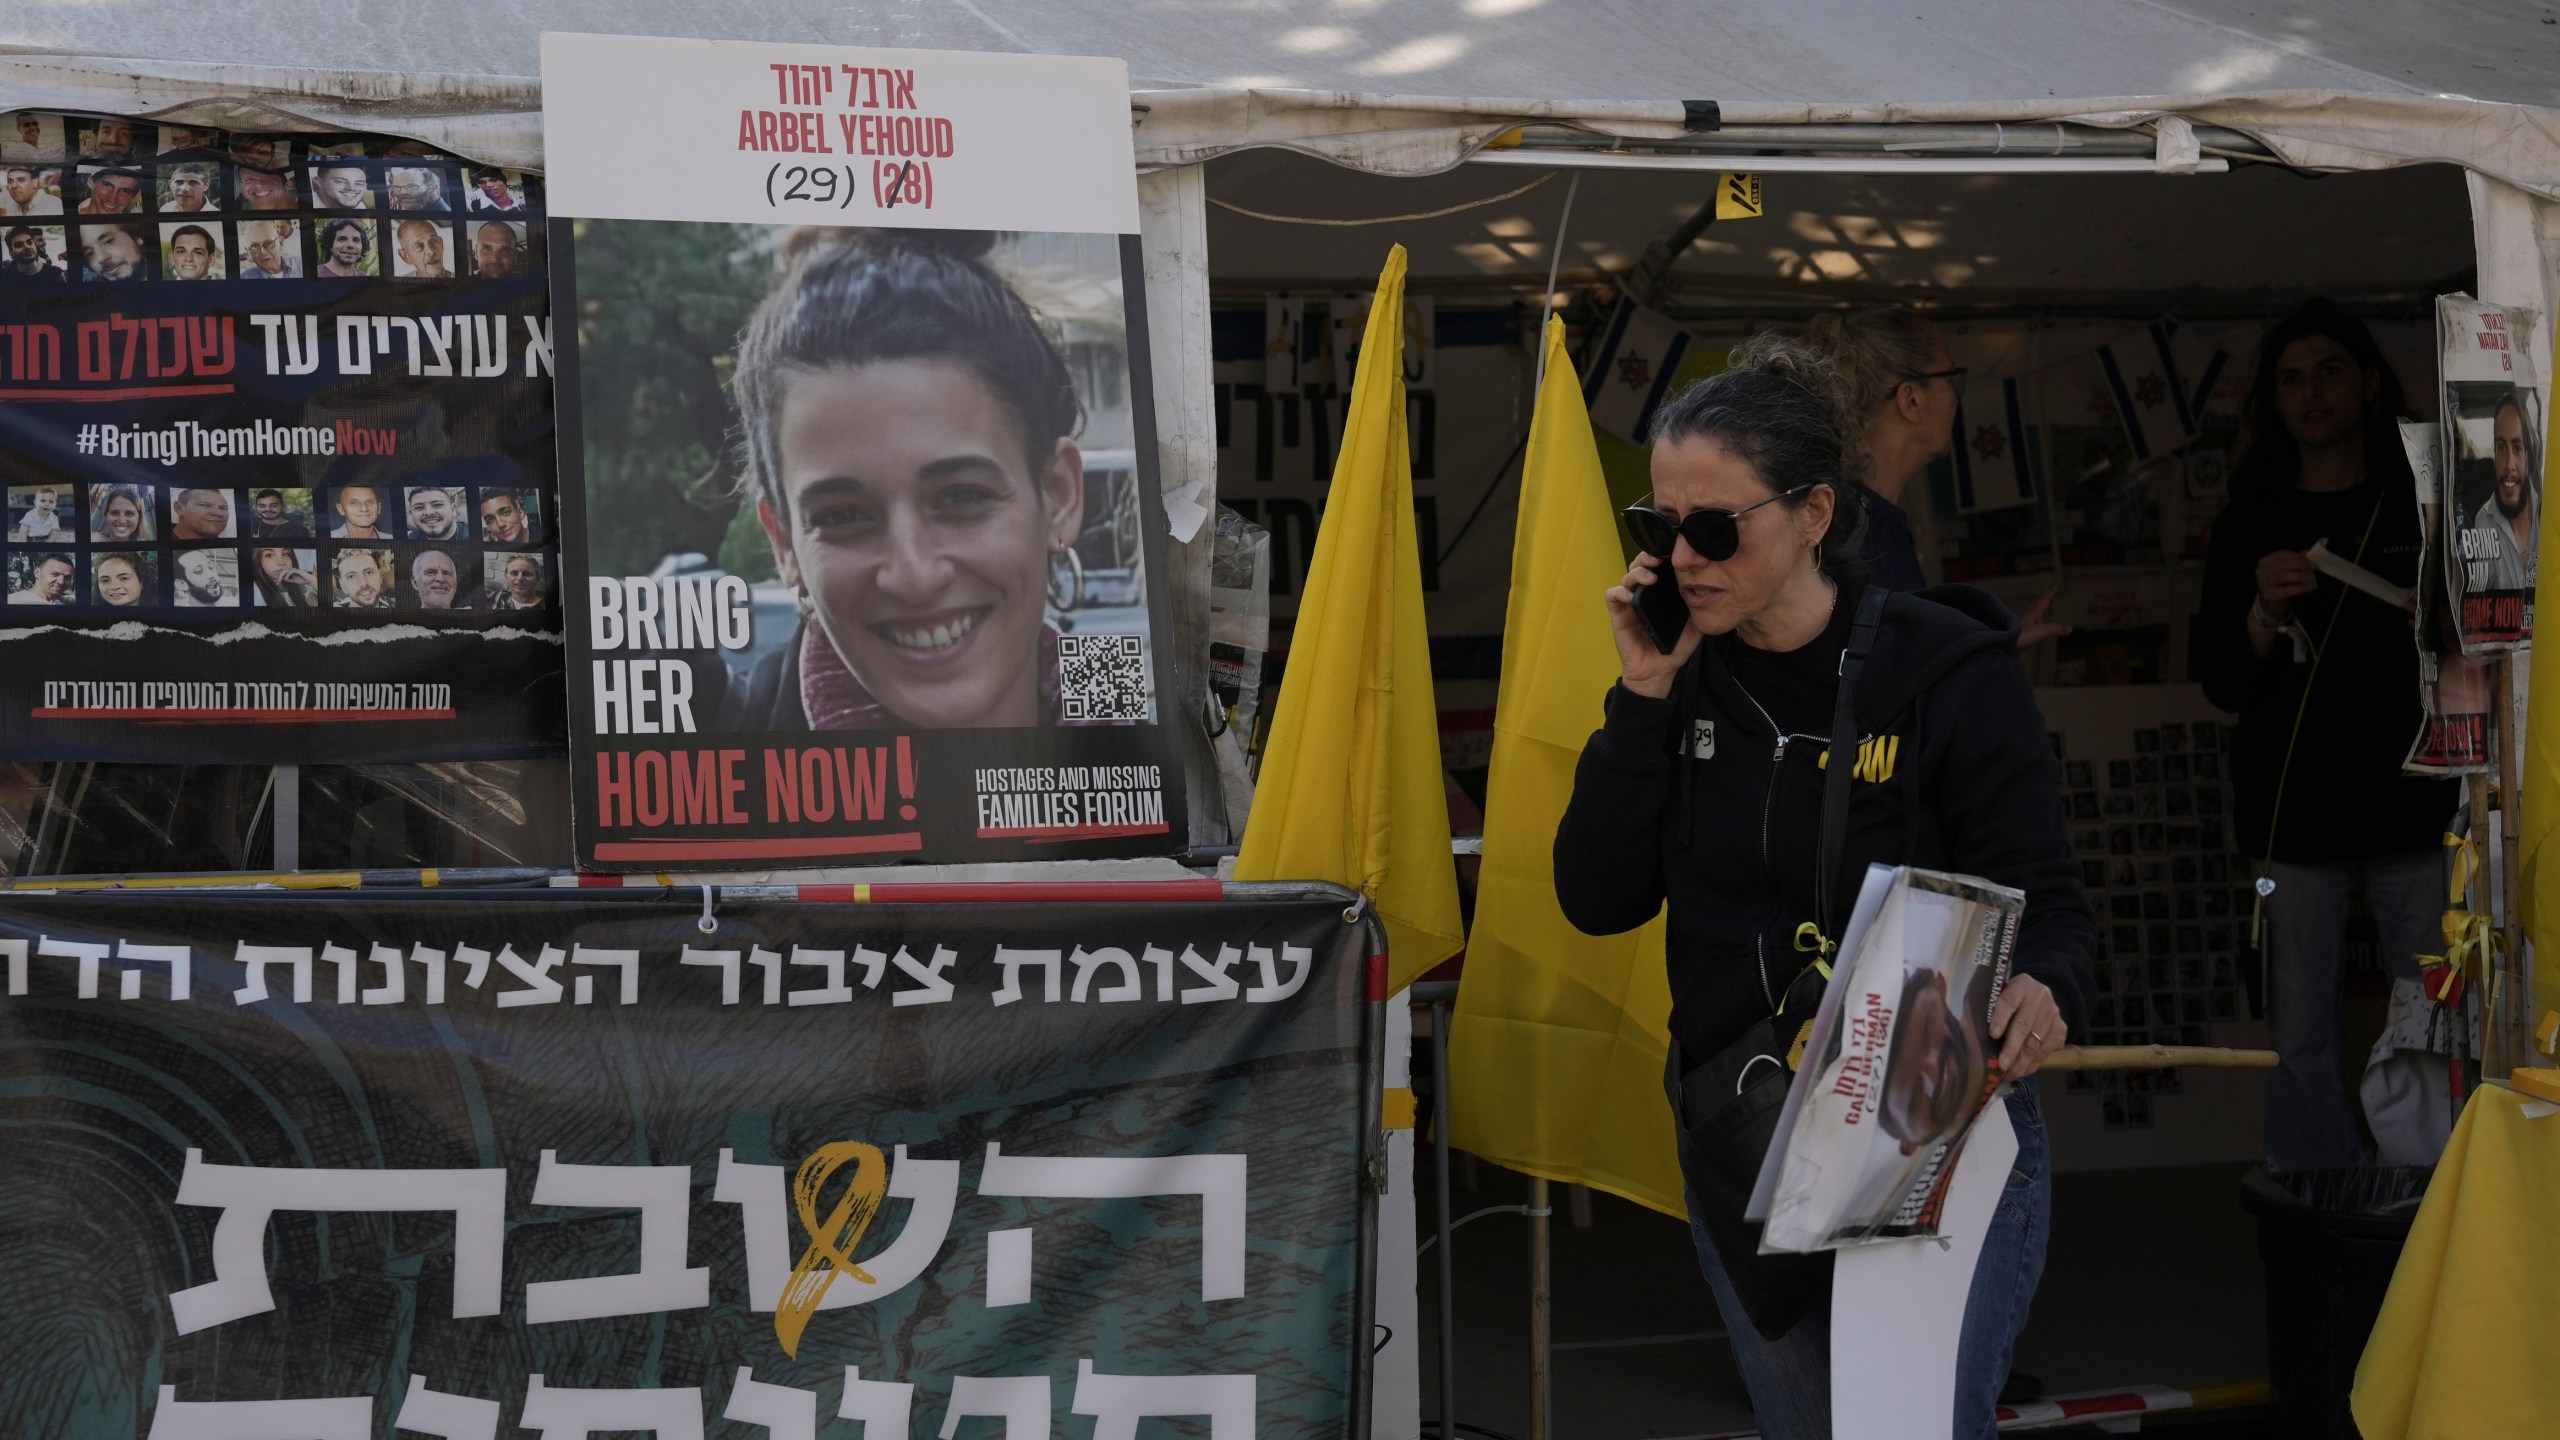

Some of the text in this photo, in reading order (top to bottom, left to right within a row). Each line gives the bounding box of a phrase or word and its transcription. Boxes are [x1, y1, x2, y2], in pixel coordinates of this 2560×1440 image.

[770, 63, 917, 109] ארבל יהוד
[738, 109, 954, 158] ARBEL YEHOUD
[766, 159, 933, 210] (29) (28)
[0, 323, 61, 381] חו
[77, 312, 236, 381] שכולם
[250, 314, 320, 376] עד
[337, 314, 508, 378] עוצרים
[77, 419, 397, 466] #BringThemHomeNow
[2462, 528, 2500, 560] BRING
[590, 575, 751, 652] BRING
[44, 680, 451, 710] מטה המשפחות להחזרת החטופים והנעדרים
[592, 658, 697, 735] HER
[597, 735, 919, 827] HOME NOW!
[975, 765, 1161, 792] HOSTAGES AND MISSING
[977, 791, 1164, 829] FAMILIES FORUM
[233, 940, 640, 1009] הציונות
[681, 942, 956, 1008] ציבור
[991, 941, 1313, 1007] עצומת
[1831, 1017, 1866, 1098] גלי ברמן
[1845, 1082, 1869, 1125] GALI
[168, 1141, 1247, 1337] השבת
